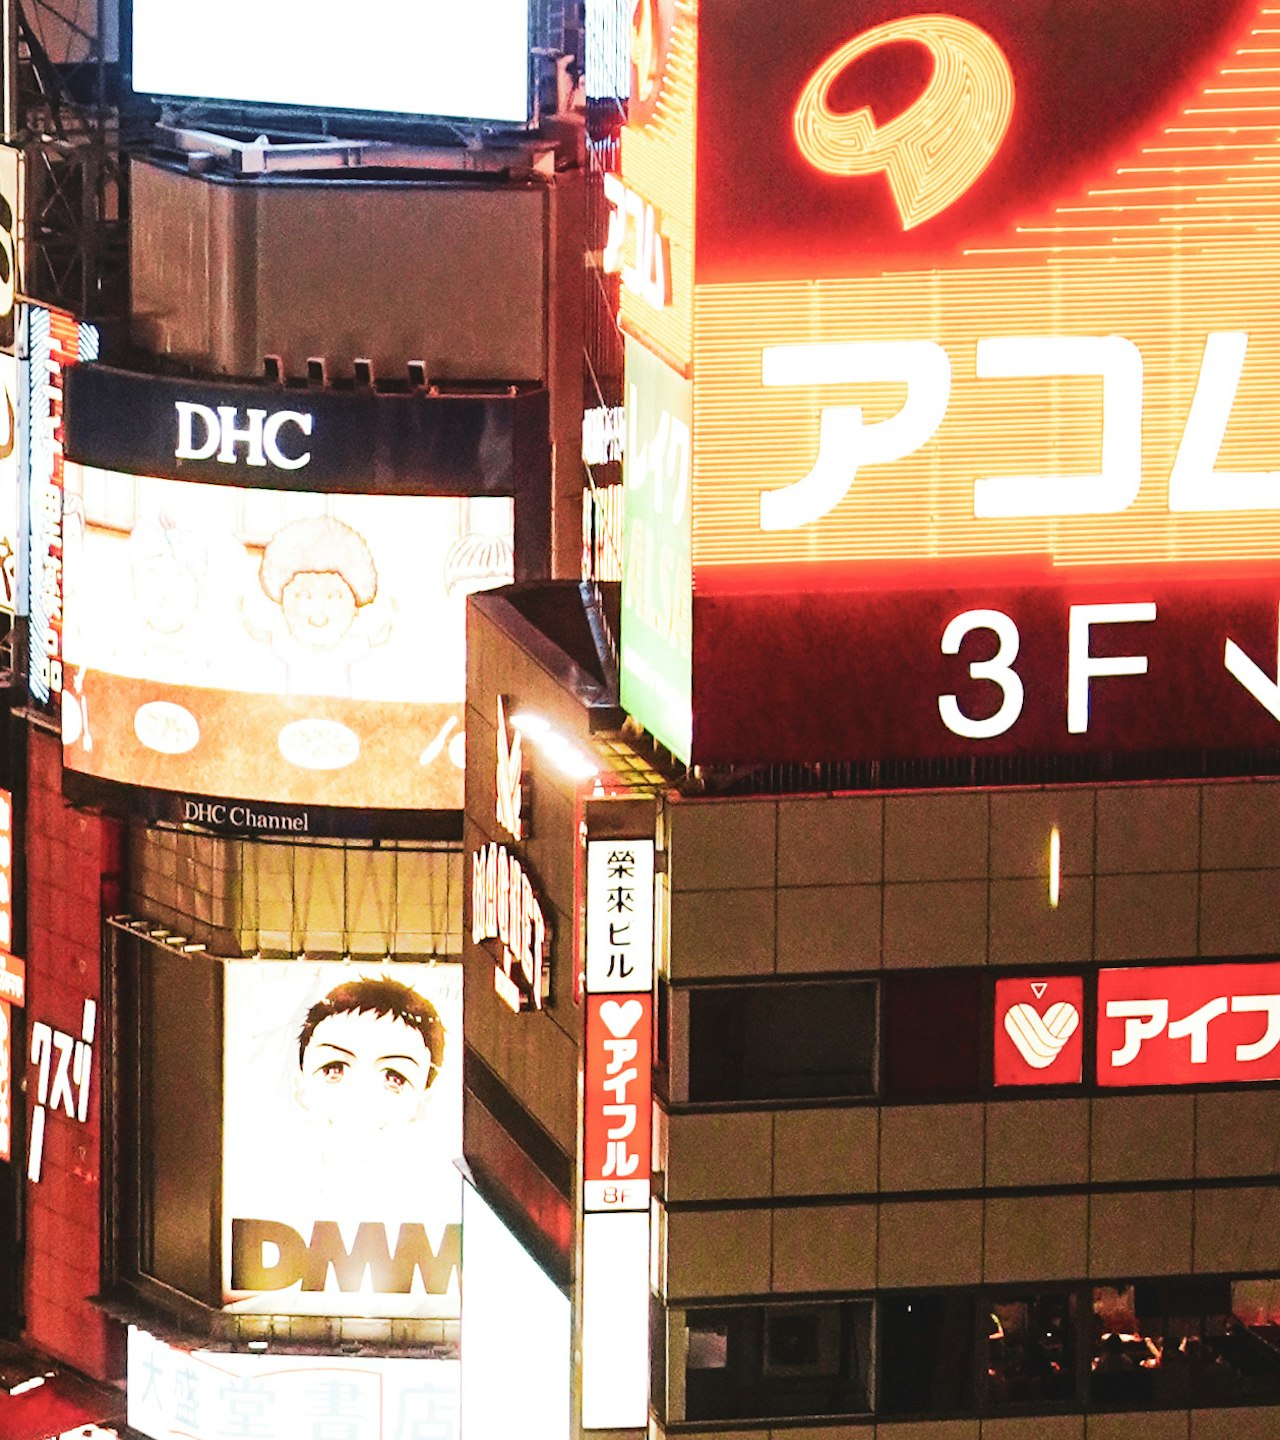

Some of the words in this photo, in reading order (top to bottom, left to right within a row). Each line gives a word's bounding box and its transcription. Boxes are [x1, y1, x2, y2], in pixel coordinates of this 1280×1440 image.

[175, 401, 312, 470] DHC
[760, 331, 1280, 532] アコム
[185, 800, 226, 824] DHC
[231, 805, 309, 832] Channel
[602, 1039, 639, 1177] アイフル
